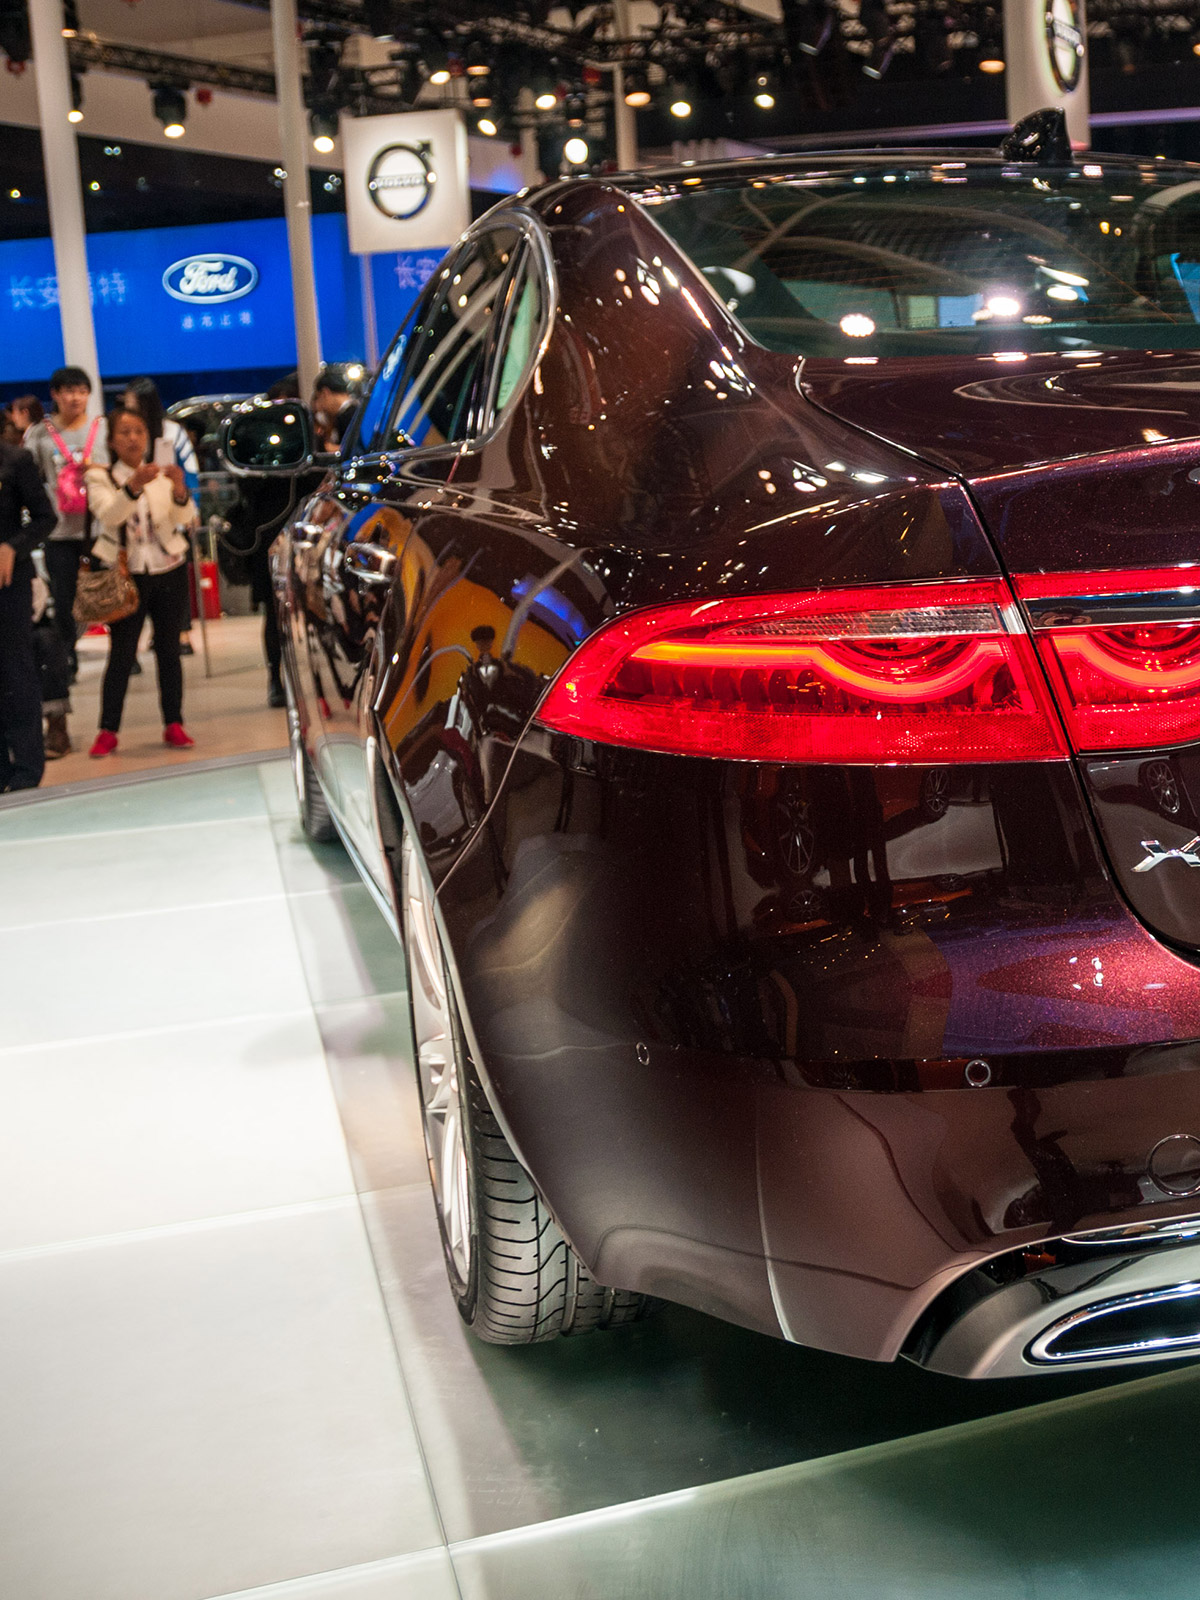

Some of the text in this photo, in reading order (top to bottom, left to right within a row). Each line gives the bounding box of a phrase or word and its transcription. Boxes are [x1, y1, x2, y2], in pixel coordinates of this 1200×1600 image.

[9, 268, 127, 309] 长安特
[179, 260, 239, 295] Ford
